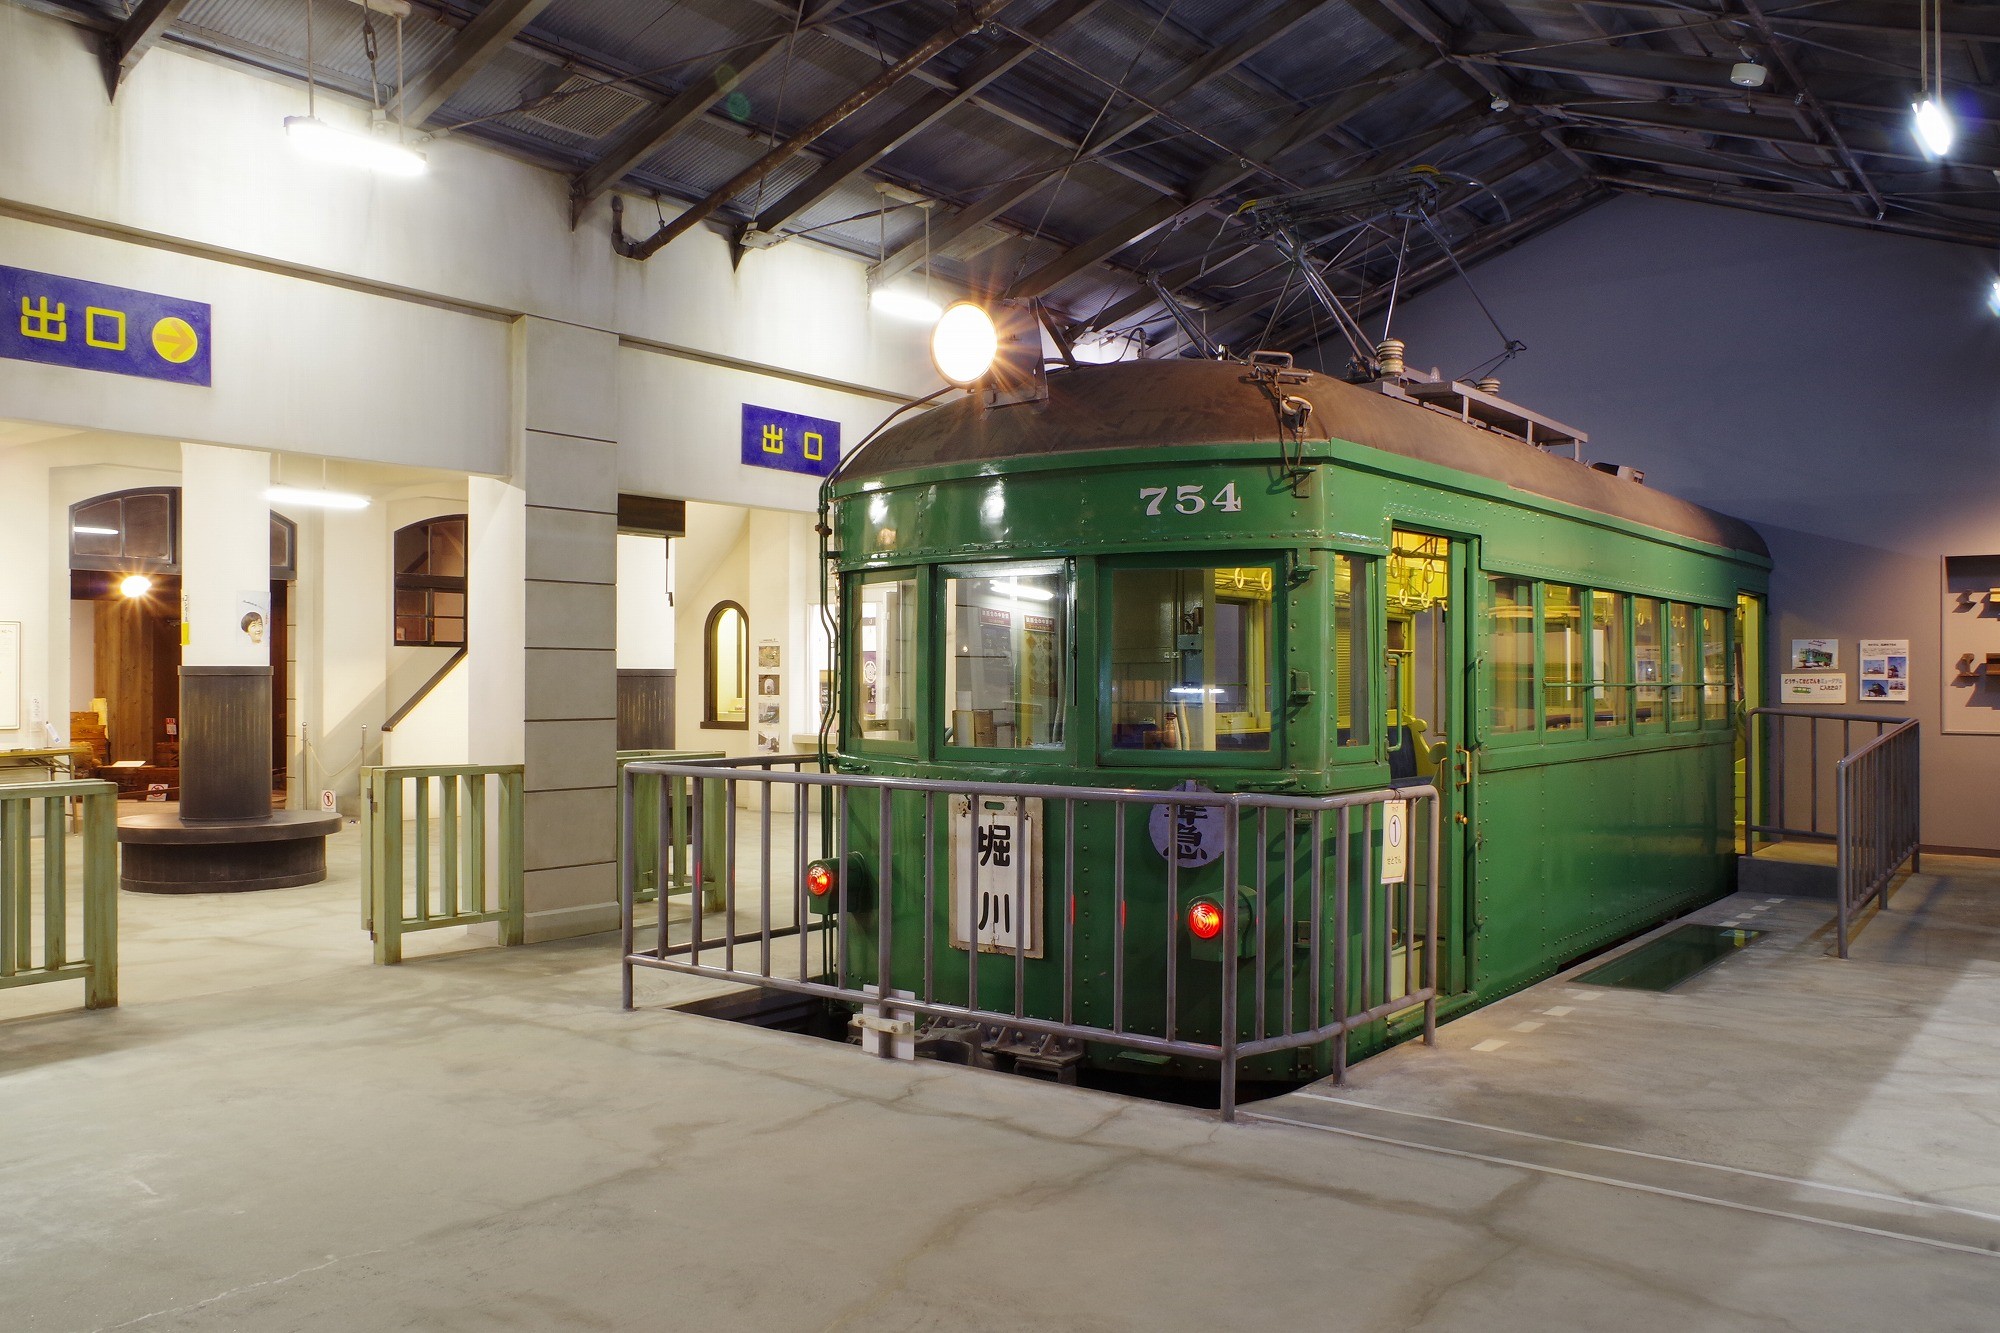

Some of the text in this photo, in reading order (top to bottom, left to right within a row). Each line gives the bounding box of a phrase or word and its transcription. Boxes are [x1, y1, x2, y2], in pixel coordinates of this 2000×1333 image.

[20, 295, 126, 351] 出口
[763, 424, 823, 461] 出口
[1139, 482, 1242, 517] 754
[977, 824, 1011, 934] 堀川
